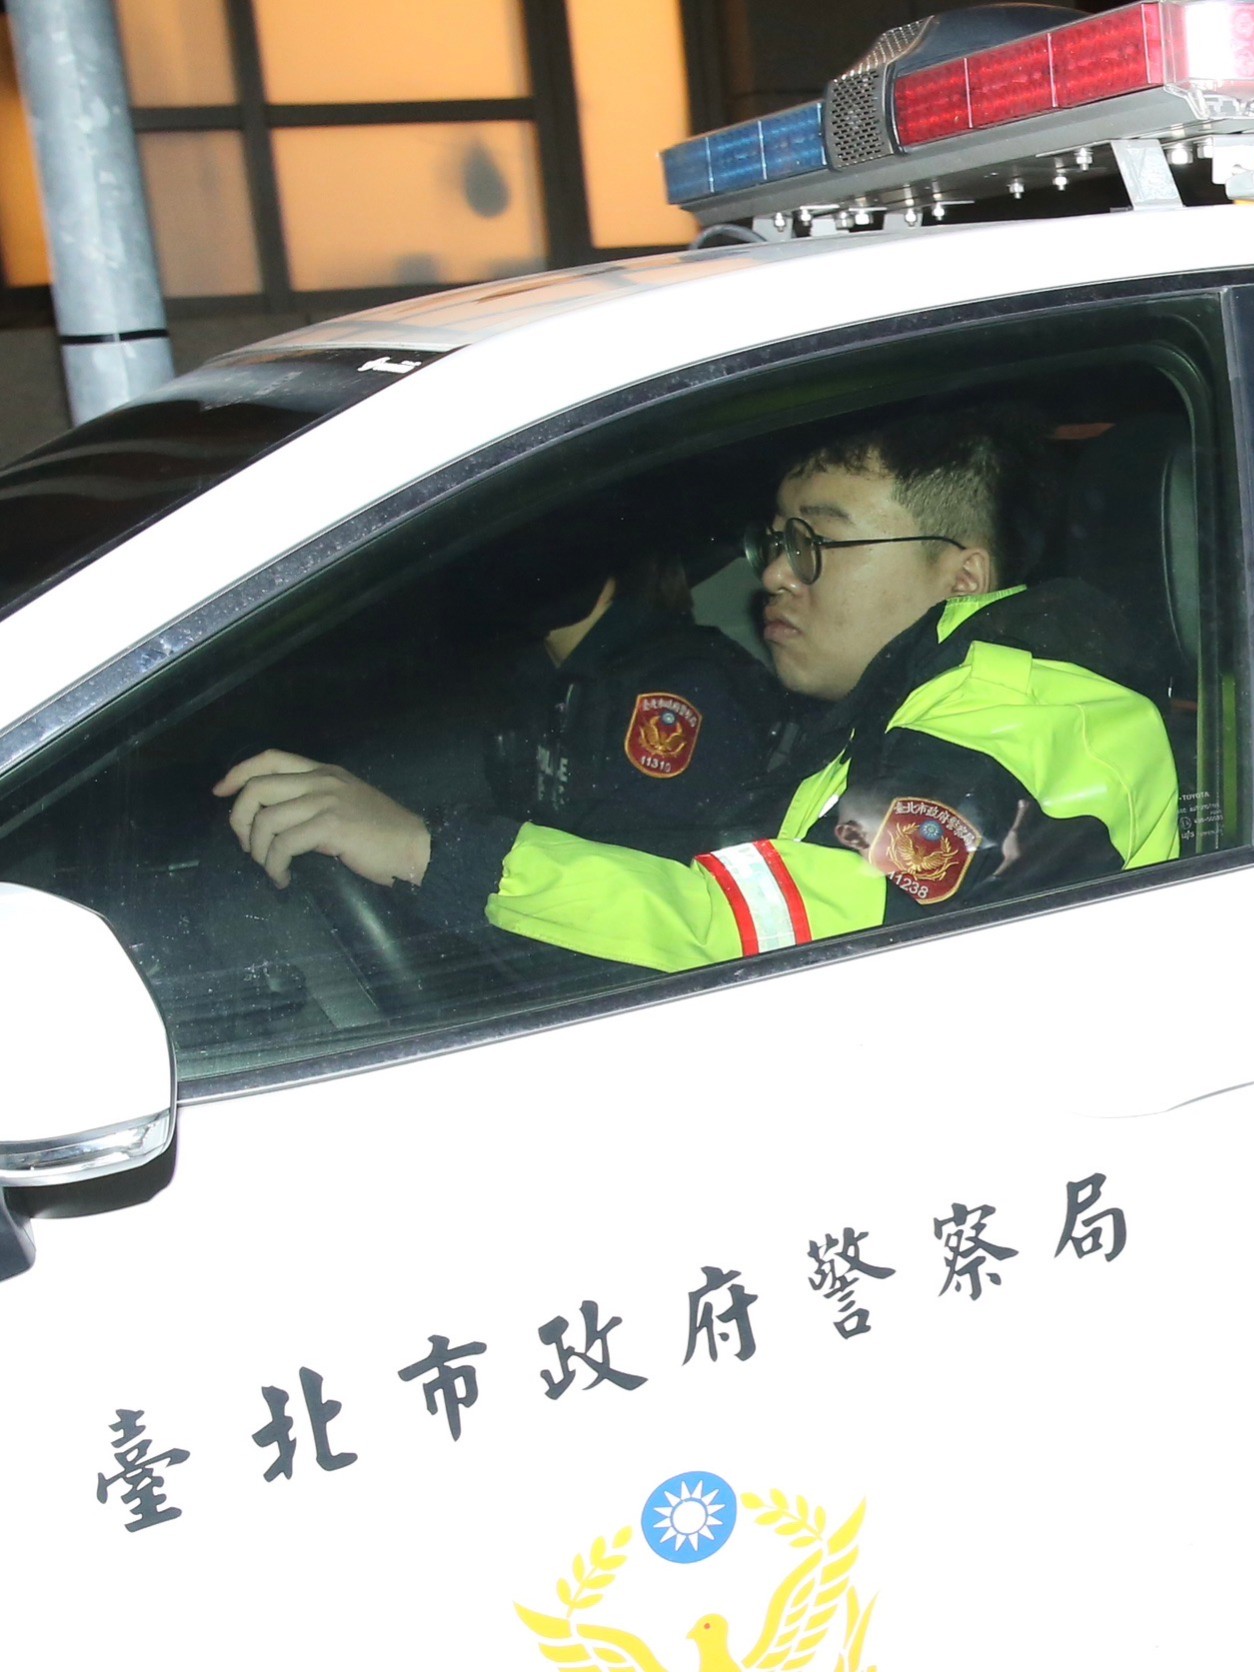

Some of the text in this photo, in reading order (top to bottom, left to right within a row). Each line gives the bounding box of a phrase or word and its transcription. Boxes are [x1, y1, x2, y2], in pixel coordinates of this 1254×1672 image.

[888, 871, 929, 899] 11238
[97, 1173, 1127, 1533] 臺北市政府警察局
